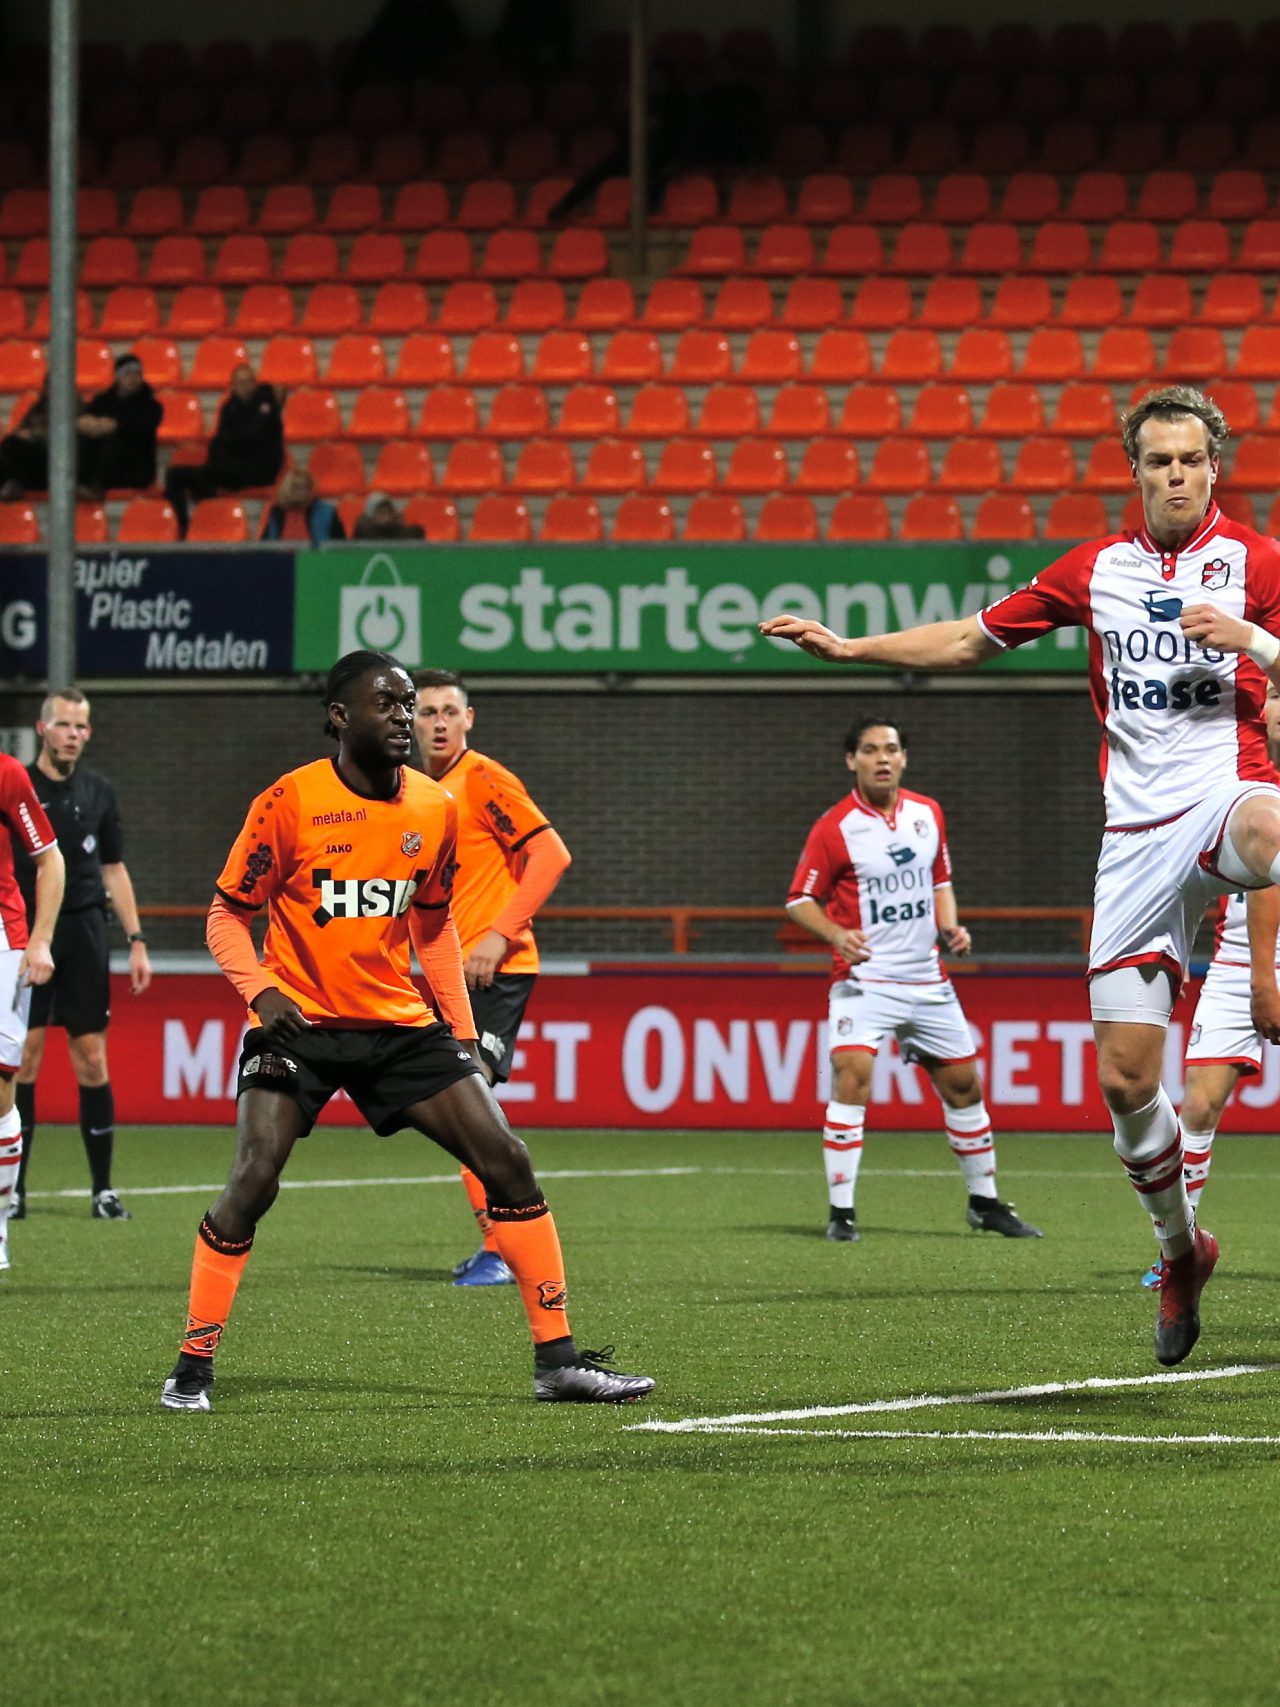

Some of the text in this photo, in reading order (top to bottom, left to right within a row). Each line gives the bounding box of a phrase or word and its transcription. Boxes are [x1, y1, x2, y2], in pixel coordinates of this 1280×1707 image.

[89, 592, 192, 630] Plastic
[146, 631, 267, 670] Metalen
[1111, 668, 1222, 711] lease
[312, 808, 367, 826] metafa.nl
[325, 844, 352, 854] JAKO
